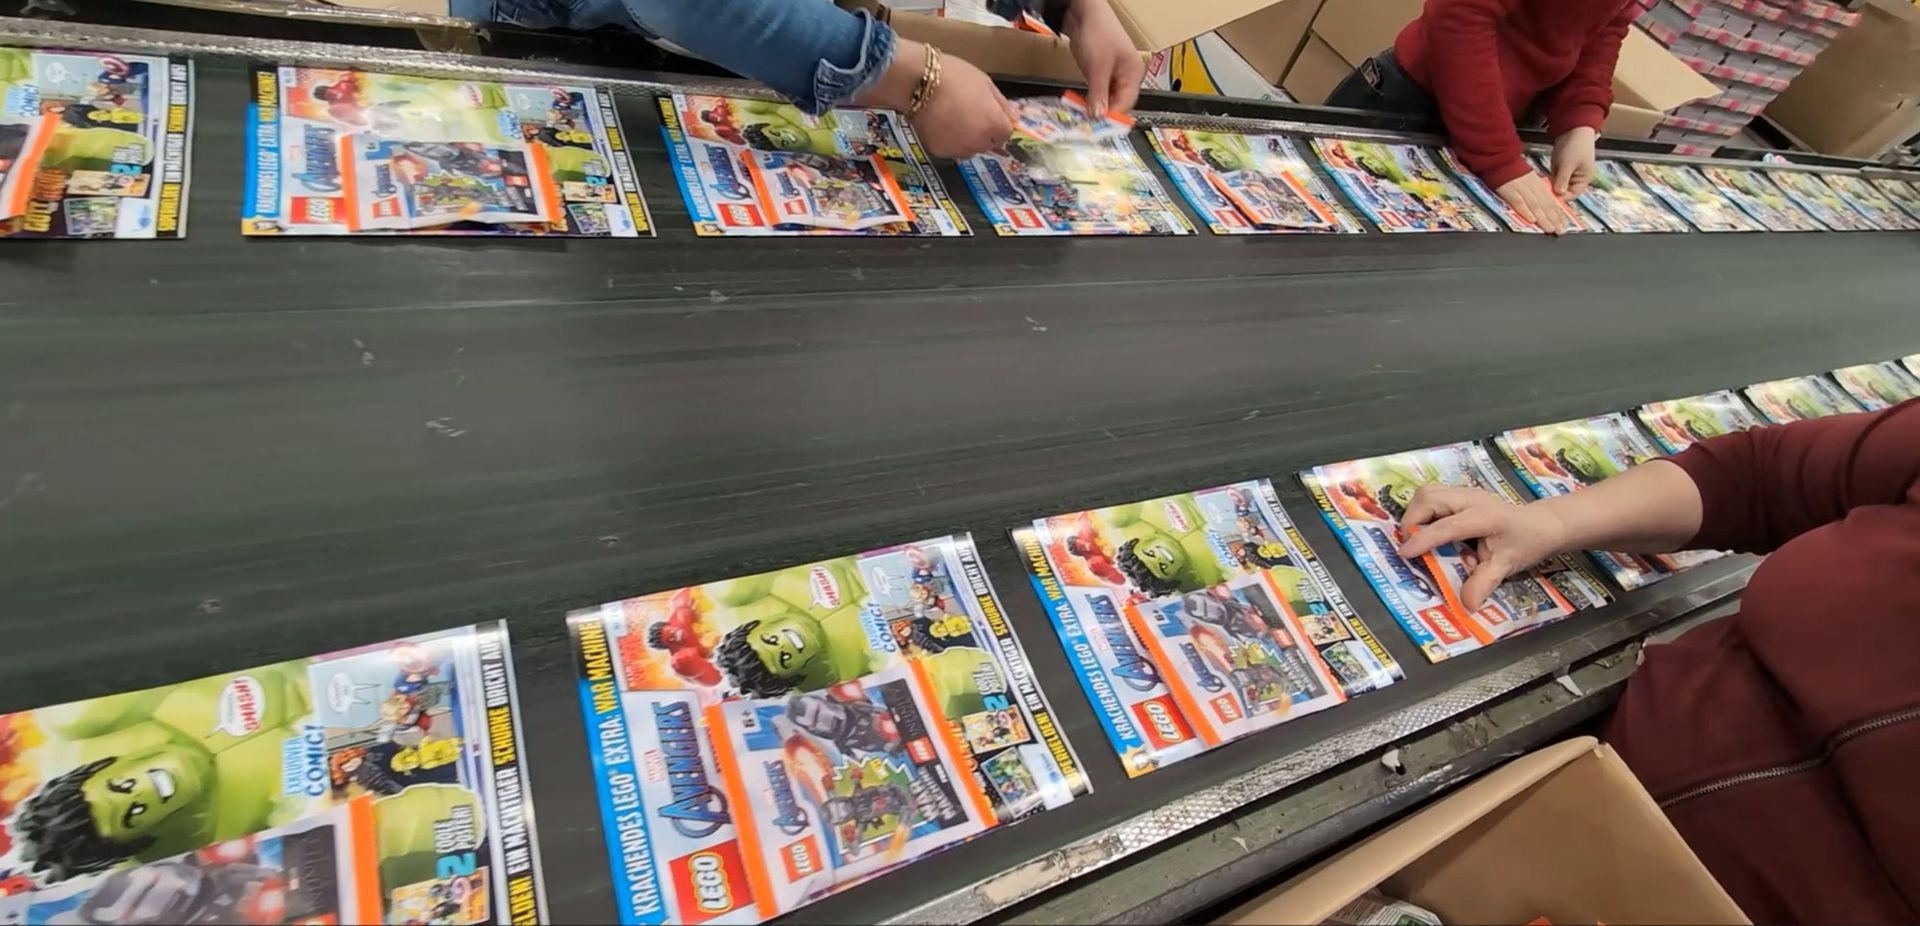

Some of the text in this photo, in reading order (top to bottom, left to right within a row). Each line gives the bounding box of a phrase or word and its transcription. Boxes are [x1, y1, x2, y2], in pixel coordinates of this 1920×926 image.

[308, 198, 333, 220] LEGO
[963, 562, 989, 596] BRICHT
[1041, 577, 1064, 601] WAR
[867, 602, 897, 652] COMIC!
[979, 595, 1009, 637] SCHURKE
[1055, 600, 1082, 637] EXTRA:
[1308, 602, 1329, 616] 2
[1427, 610, 1461, 640] LEGO
[1085, 594, 1163, 692] AVENGERS
[482, 662, 509, 708] BRICHT
[1000, 637, 1035, 696] MÄCHTIGER
[233, 680, 261, 731] SMASH!
[590, 681, 619, 715] WAR
[982, 693, 1011, 712] 2
[1024, 692, 1044, 712] EIN
[1086, 670, 1137, 741] KRACHENDES
[1216, 698, 1238, 718] LEGO
[488, 706, 517, 766] SCHURKE
[598, 714, 631, 766] EXTRA:
[1144, 700, 1182, 740] LEGO
[304, 724, 326, 797] COMIC!
[651, 701, 733, 839] AVENGERS
[911, 740, 931, 761] LEGO
[494, 766, 528, 850] MÄCHTIGER
[763, 760, 810, 835] AVENGERS
[918, 765, 957, 821] MACHINE
[433, 819, 455, 854] COOLE
[452, 805, 477, 851] POSTER!
[436, 852, 478, 880] 2
[505, 847, 531, 876] EIN
[615, 812, 662, 917] KRACHENDES
[790, 843, 813, 874] LEGO
[690, 853, 732, 911] LEGO
